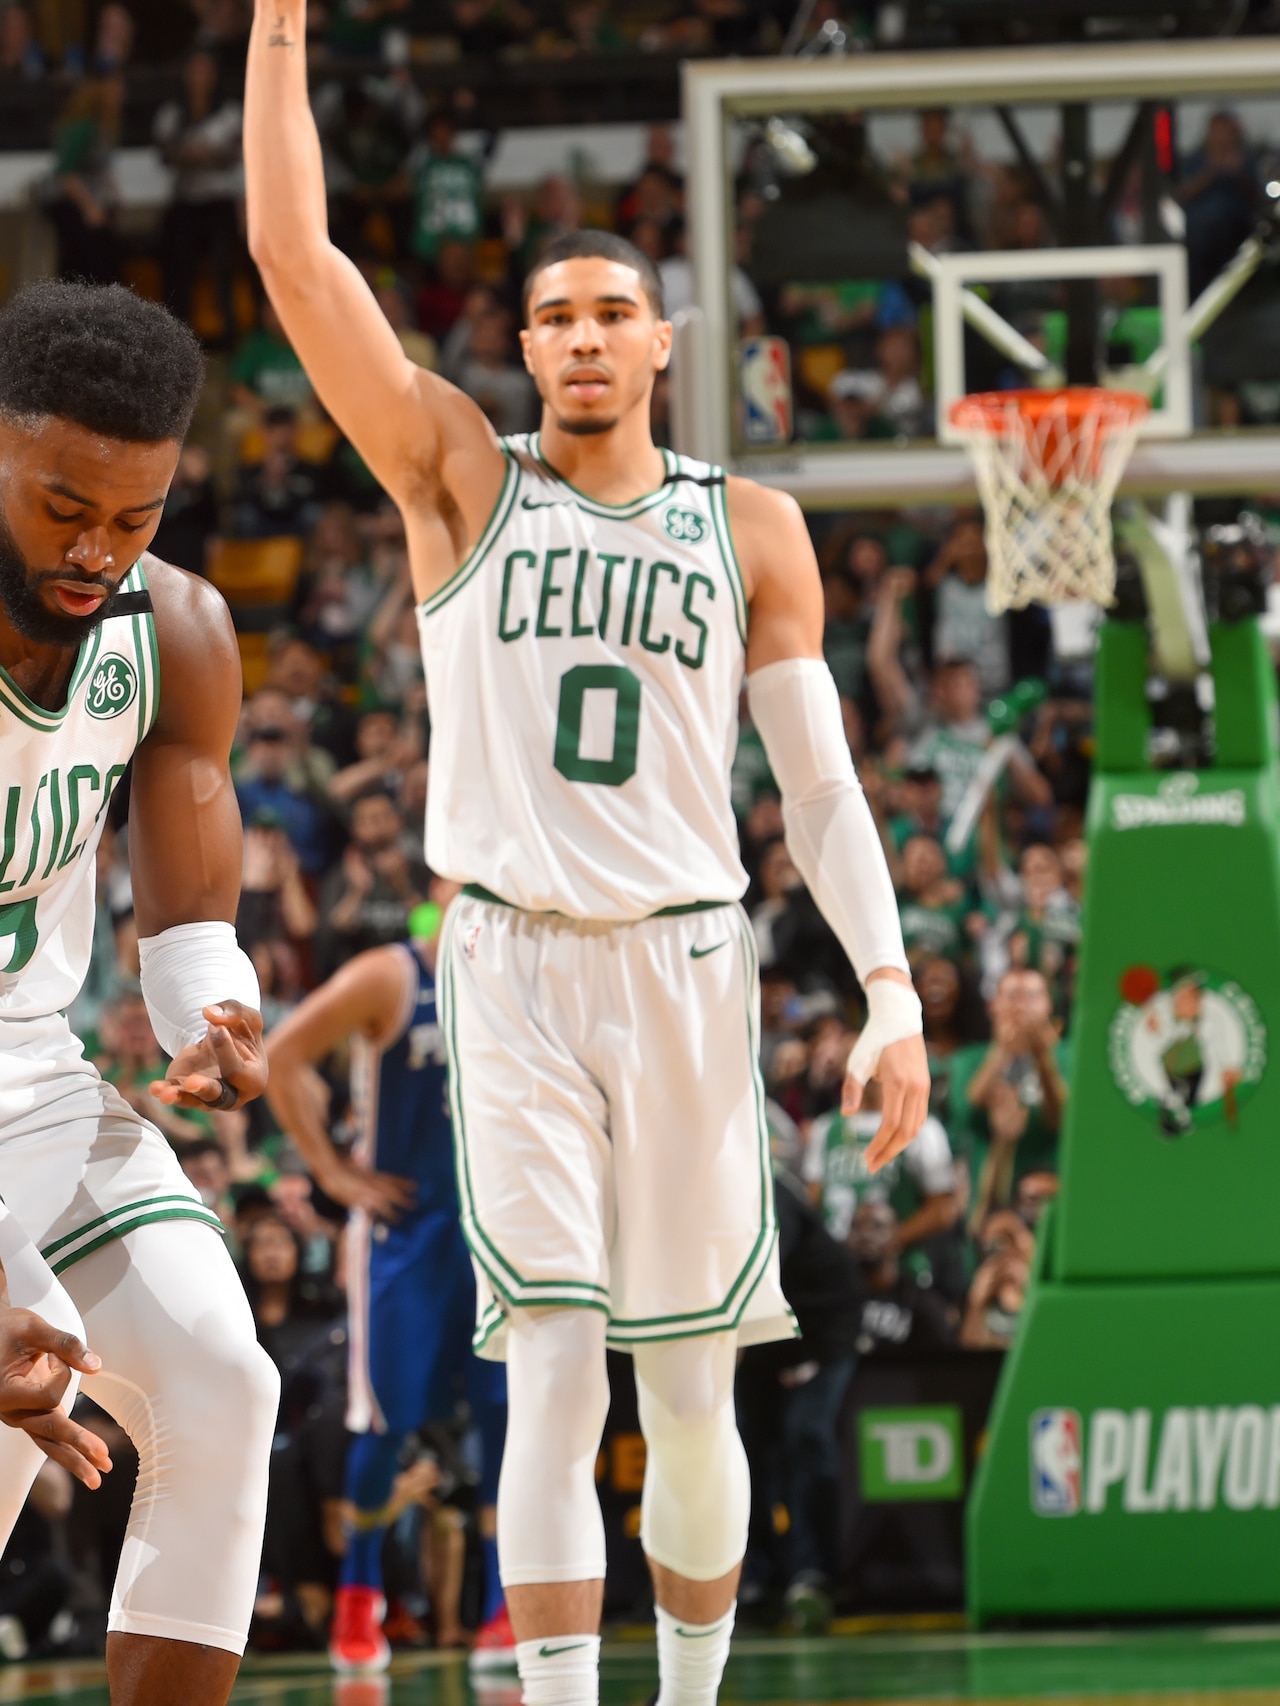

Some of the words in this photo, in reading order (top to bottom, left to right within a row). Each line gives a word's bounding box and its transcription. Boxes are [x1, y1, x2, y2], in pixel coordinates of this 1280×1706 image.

[498, 547, 715, 670] CELTICS
[553, 664, 642, 787] 0
[866, 1420, 953, 1483] TD
